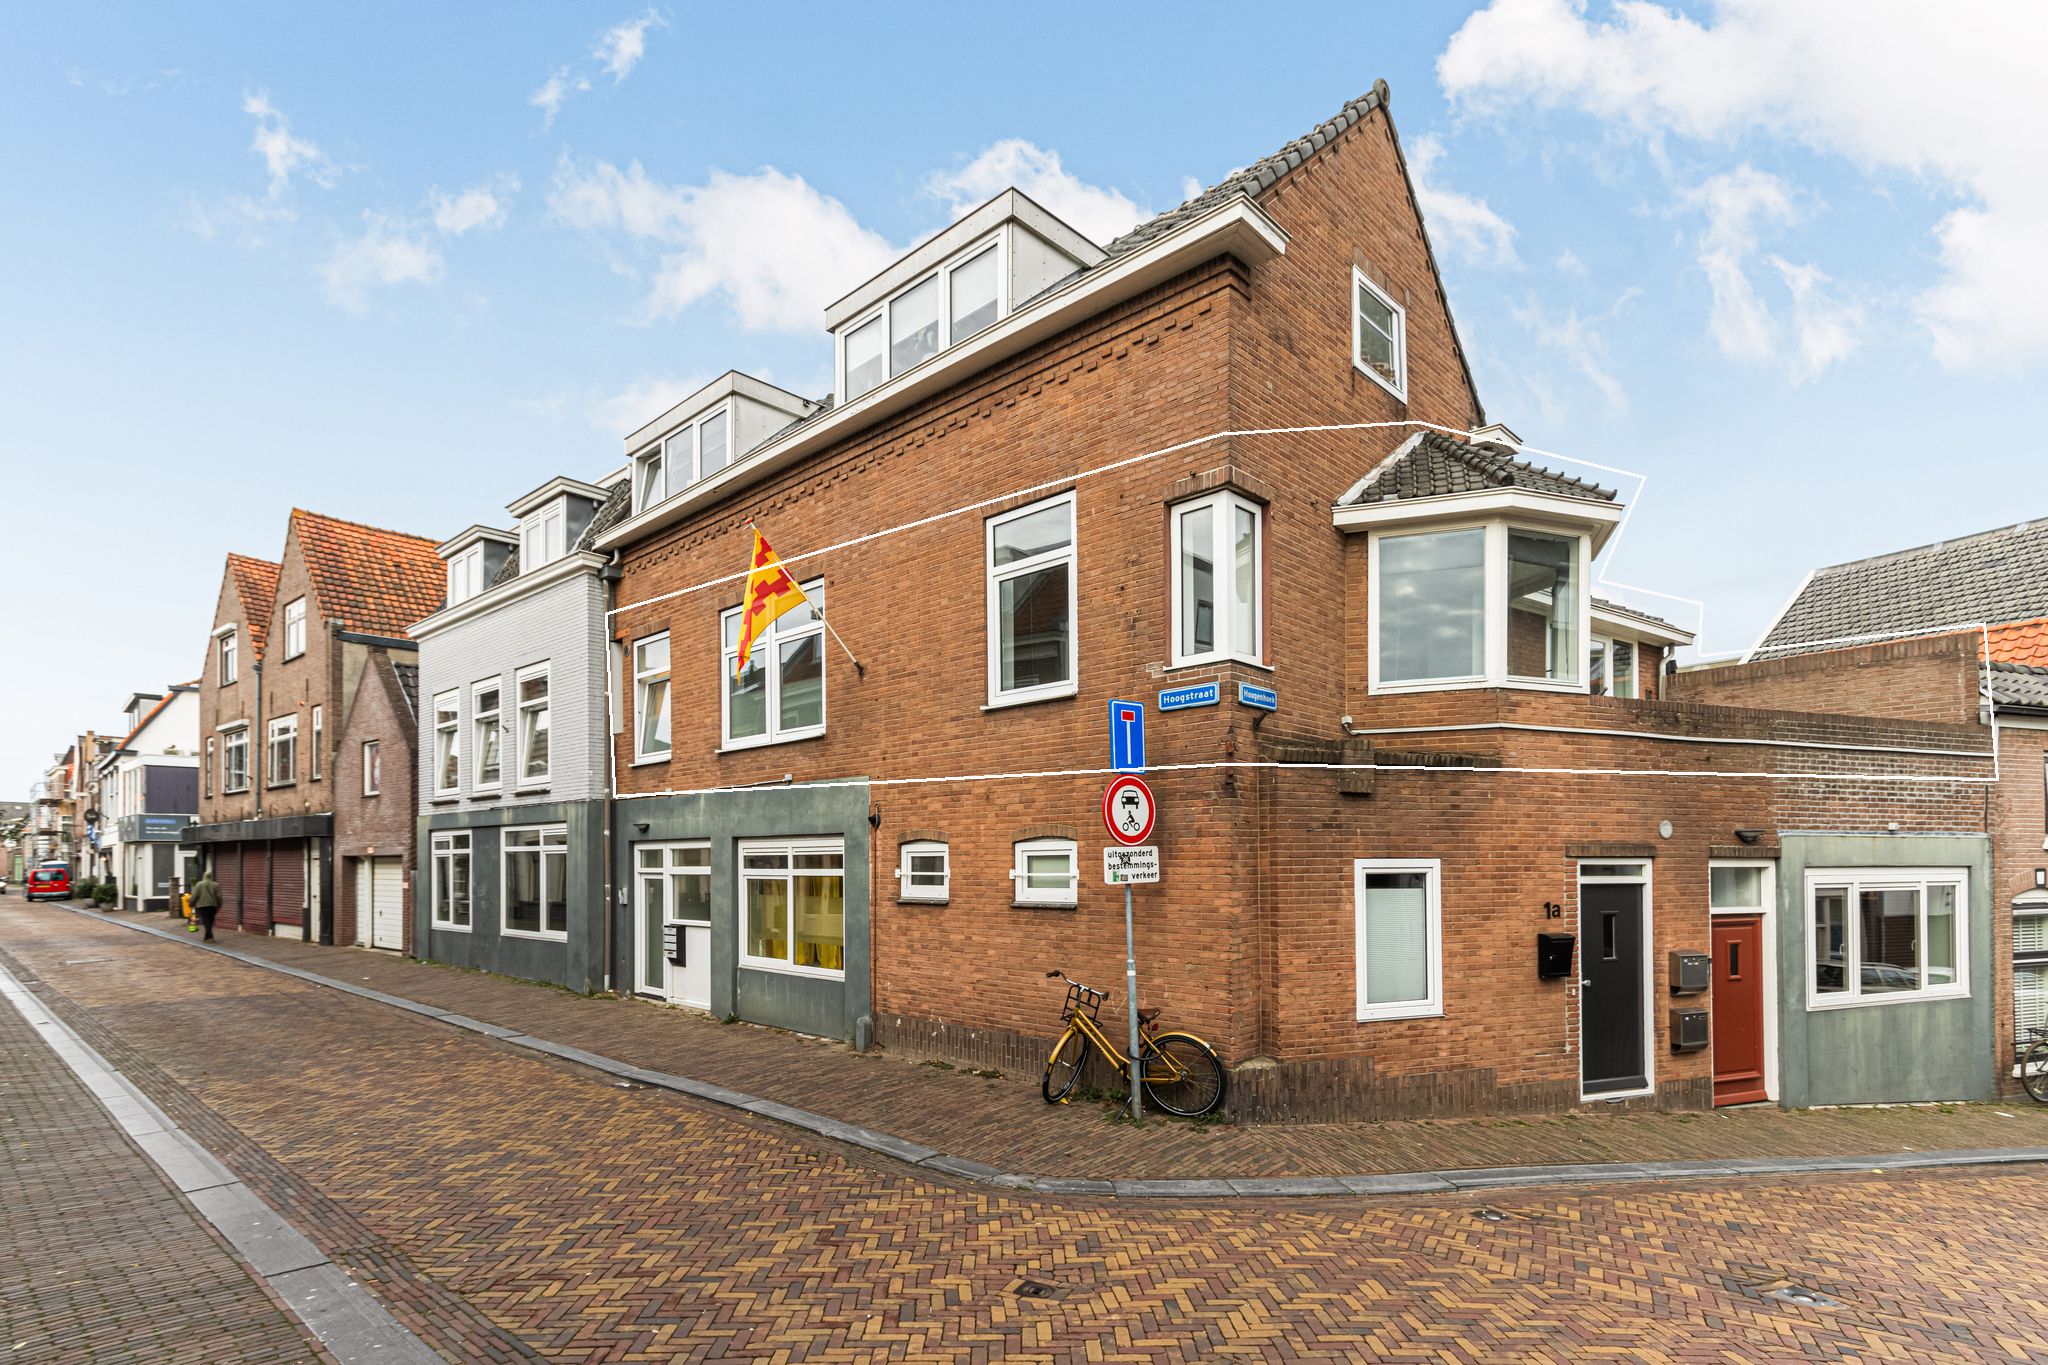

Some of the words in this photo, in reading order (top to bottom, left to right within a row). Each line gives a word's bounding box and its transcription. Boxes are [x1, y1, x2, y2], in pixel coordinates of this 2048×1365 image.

[1163, 688, 1214, 704] Hoogstraat
[1131, 872, 1158, 880] verkeer
[1543, 901, 1561, 920] 1a
